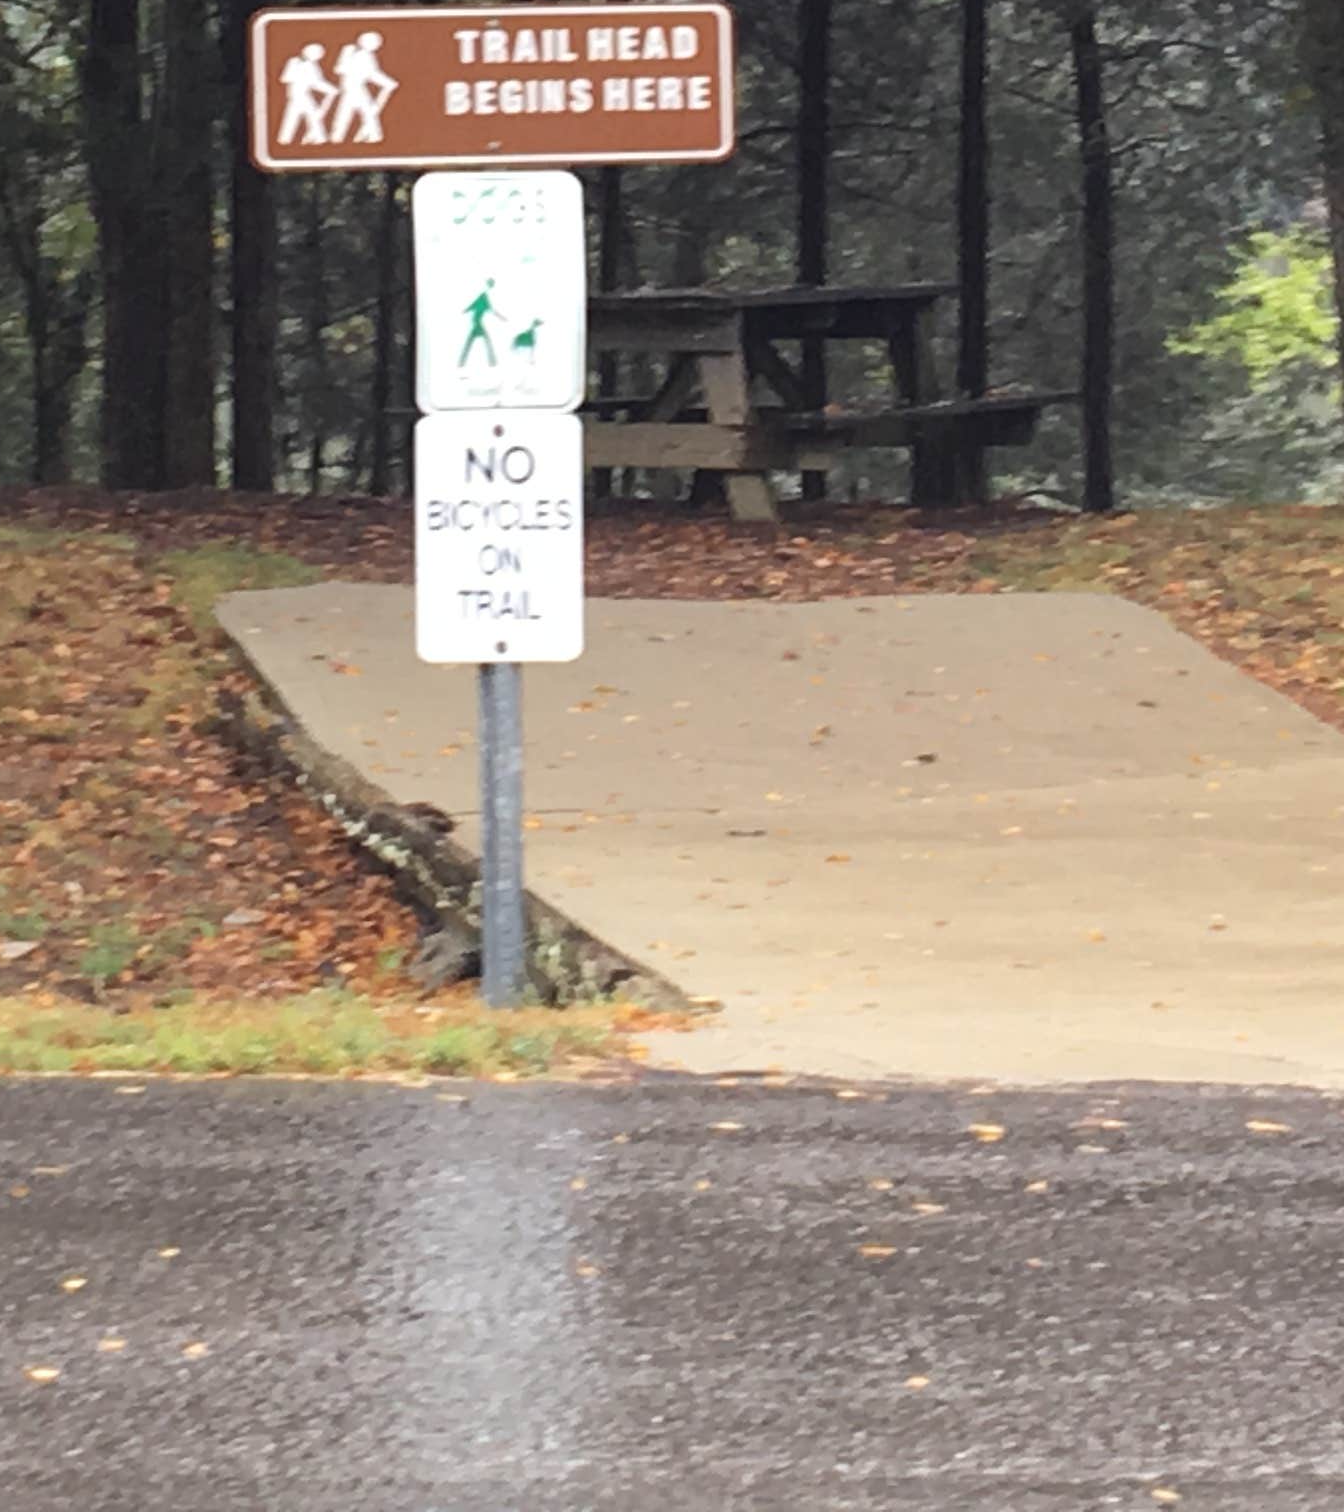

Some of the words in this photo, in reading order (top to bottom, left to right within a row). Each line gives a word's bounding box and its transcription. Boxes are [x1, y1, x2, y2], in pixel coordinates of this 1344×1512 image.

[454, 29, 579, 63] TRAIL
[586, 26, 699, 61] HEAD
[444, 80, 593, 115] BEGINS
[603, 76, 712, 111] HERE
[465, 445, 535, 484] NO
[427, 499, 572, 531] BICYCLES
[479, 543, 522, 576] ON
[456, 589, 542, 620] TRAIL
